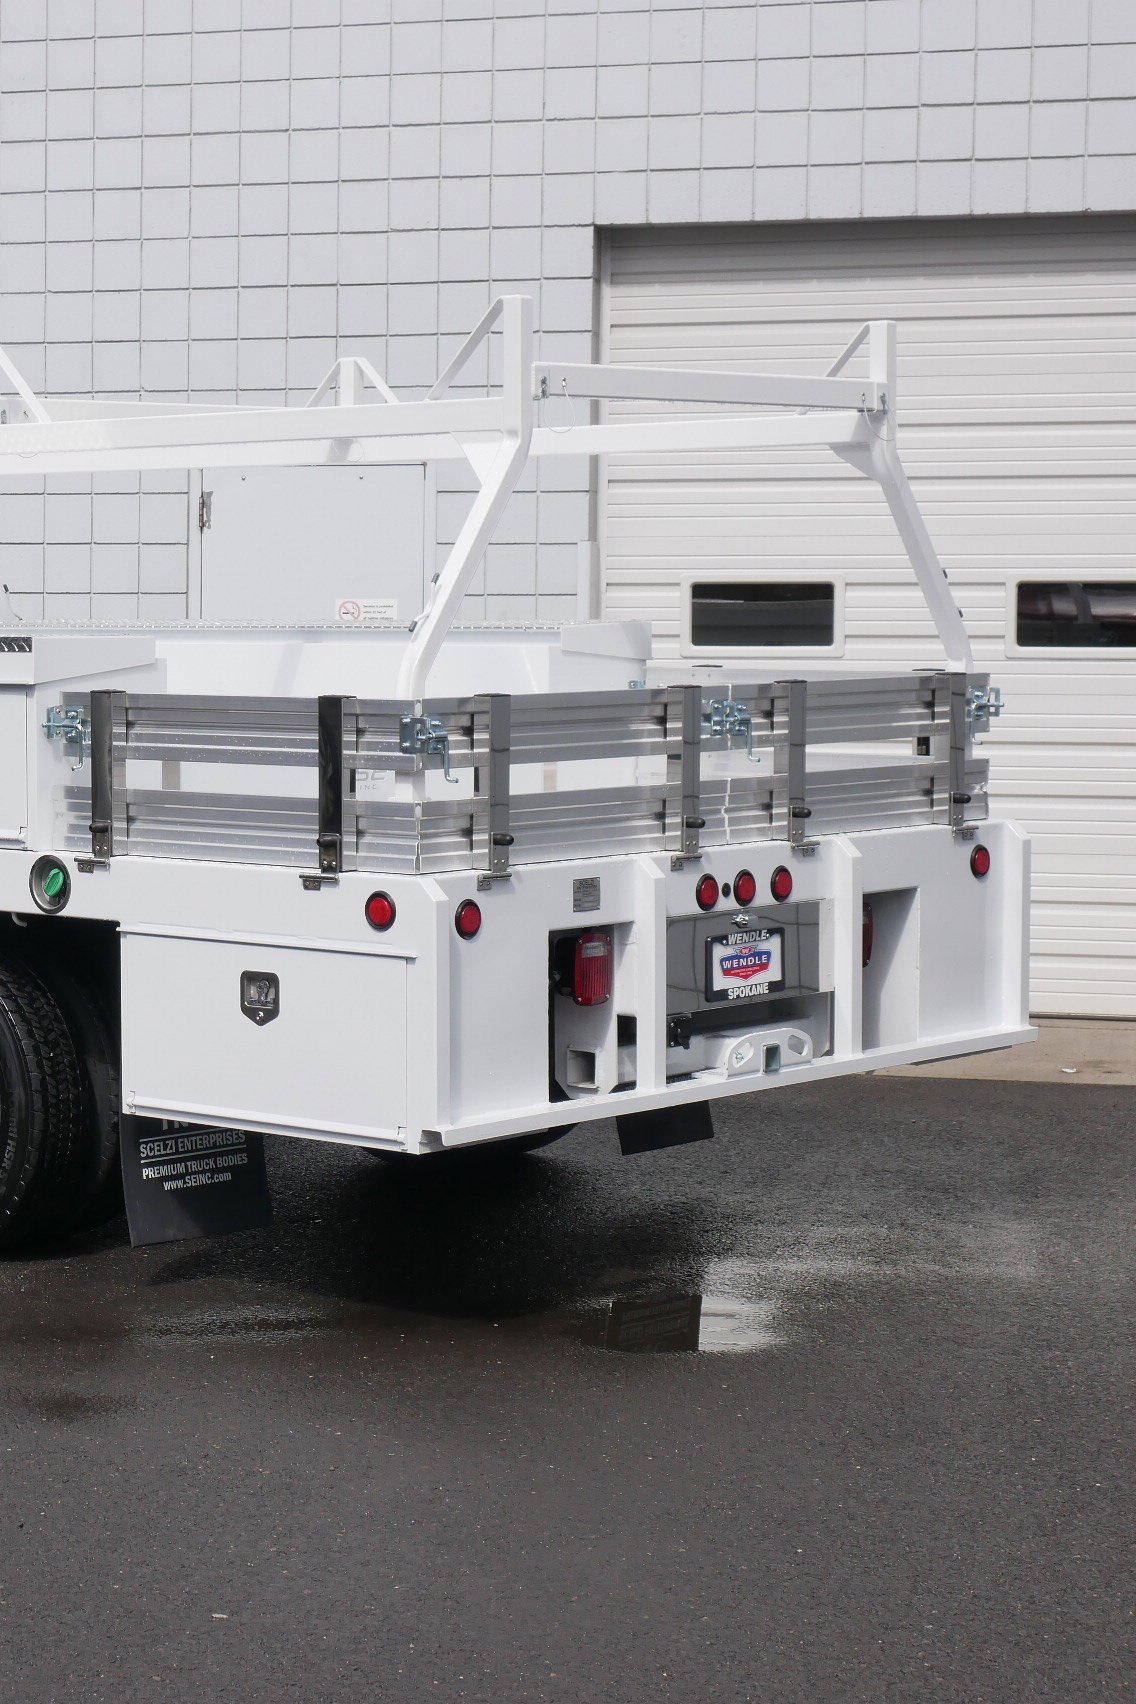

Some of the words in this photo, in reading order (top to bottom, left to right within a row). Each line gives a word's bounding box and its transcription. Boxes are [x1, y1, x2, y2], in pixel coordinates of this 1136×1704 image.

[728, 929, 768, 945] WENDLE
[722, 954, 768, 969] WENDLE
[728, 983, 769, 999] SPOKANE
[139, 1139, 176, 1158] SCELZI
[177, 1129, 246, 1153] ENTERPRISES
[142, 1162, 186, 1180] PREMIUM
[186, 1157, 215, 1172] TRUCK
[216, 1152, 248, 1168] BODIES
[162, 1171, 232, 1191] www.SEINC.com
